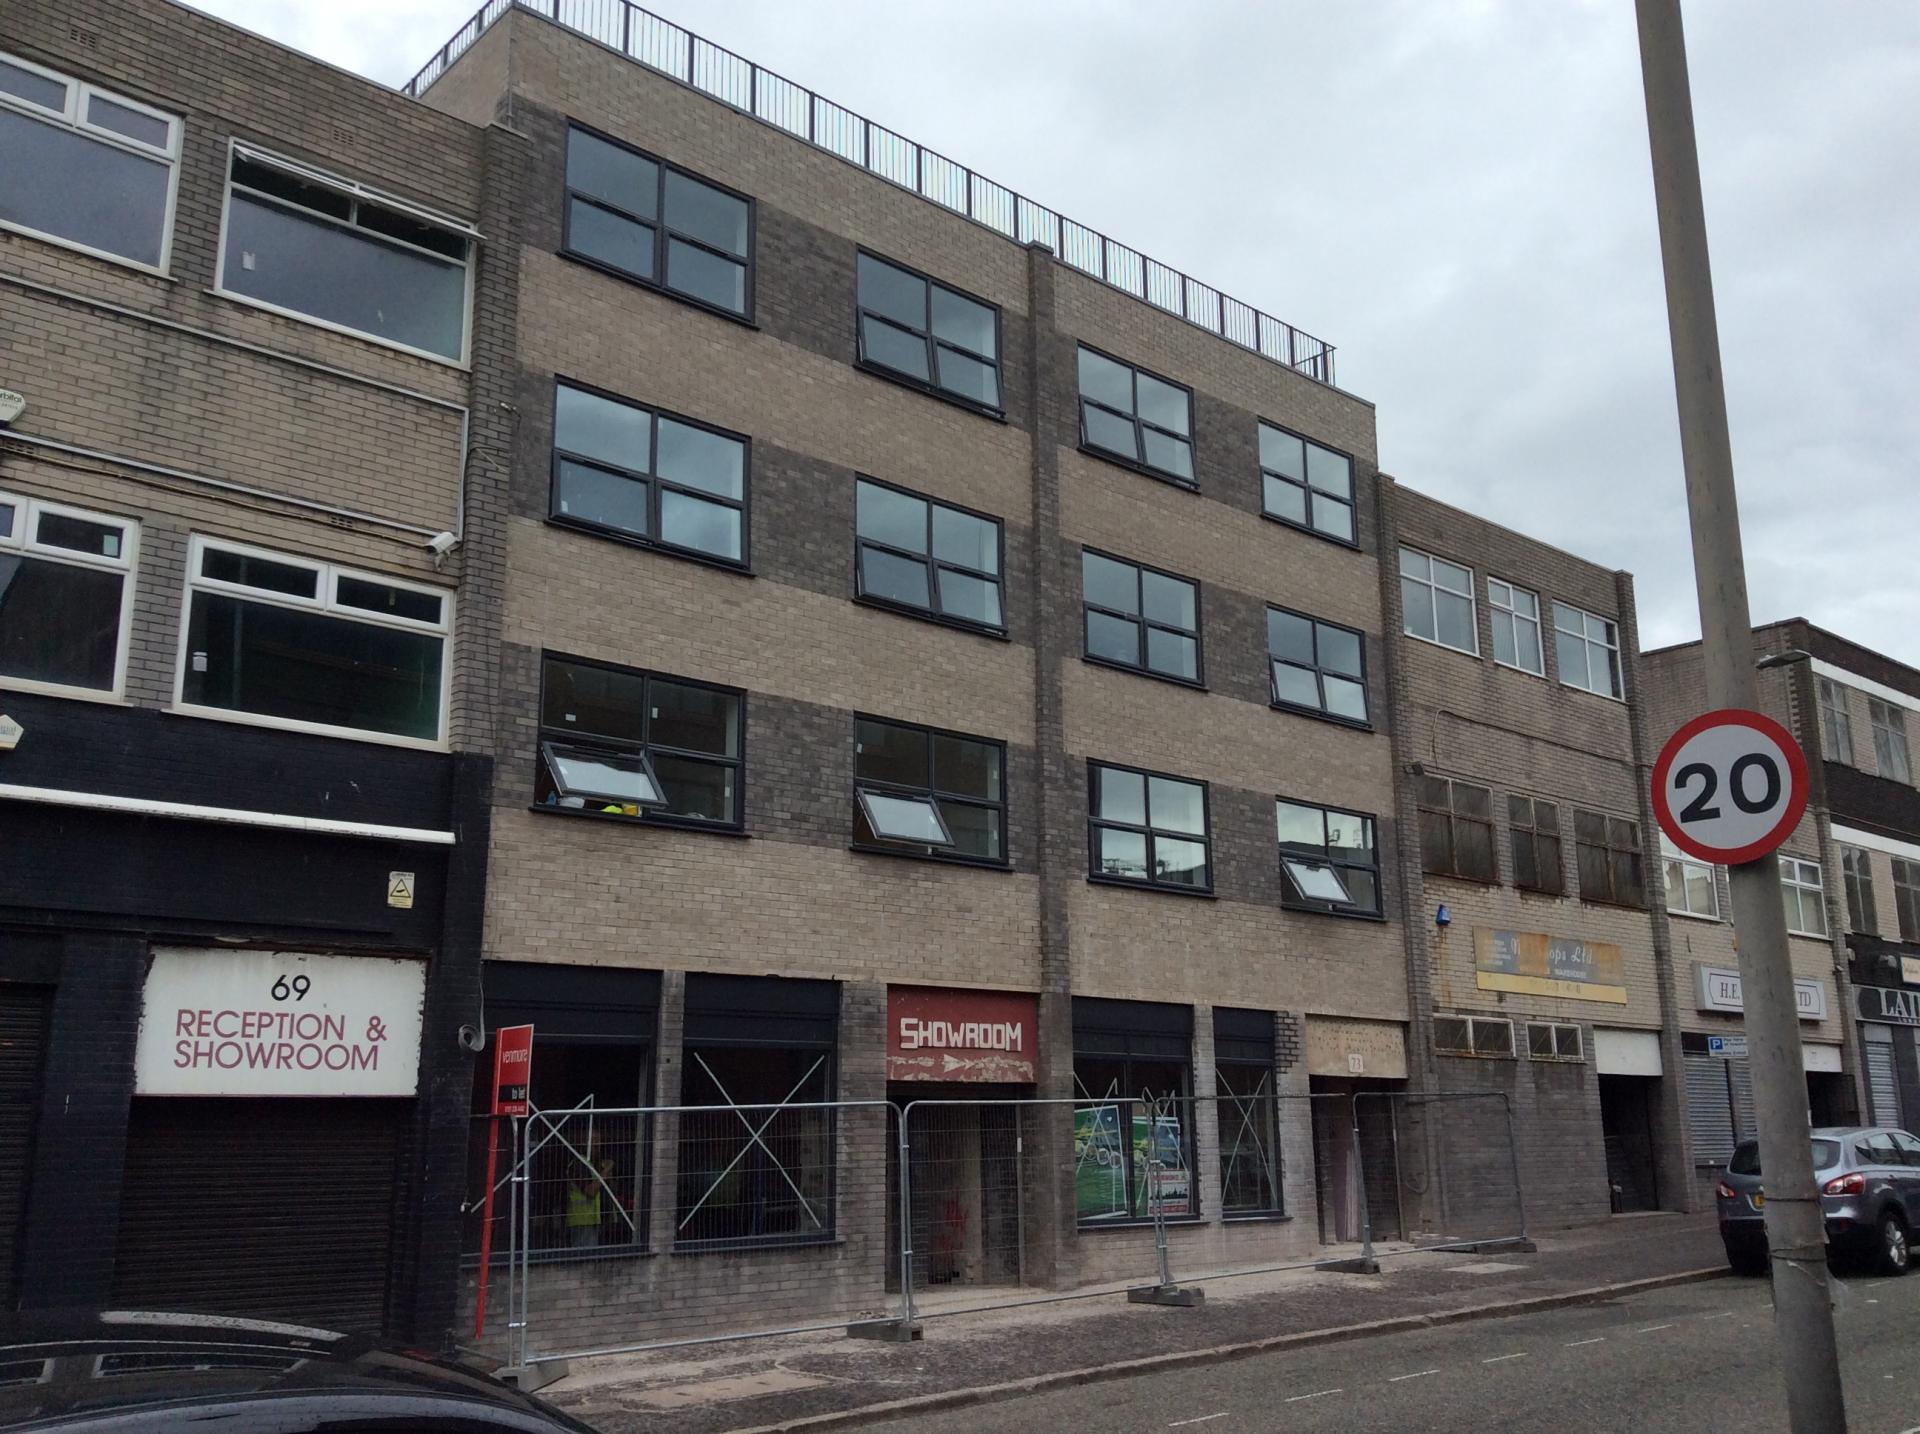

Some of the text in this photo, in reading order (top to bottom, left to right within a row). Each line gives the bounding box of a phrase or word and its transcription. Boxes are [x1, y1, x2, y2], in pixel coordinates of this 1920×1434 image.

[1674, 752, 1781, 824] 20
[270, 974, 311, 1001] 69
[175, 1009, 388, 1042] RECEPTION &
[900, 1017, 1022, 1052] SHOWROOM
[173, 1040, 379, 1071] SHOWROOM
